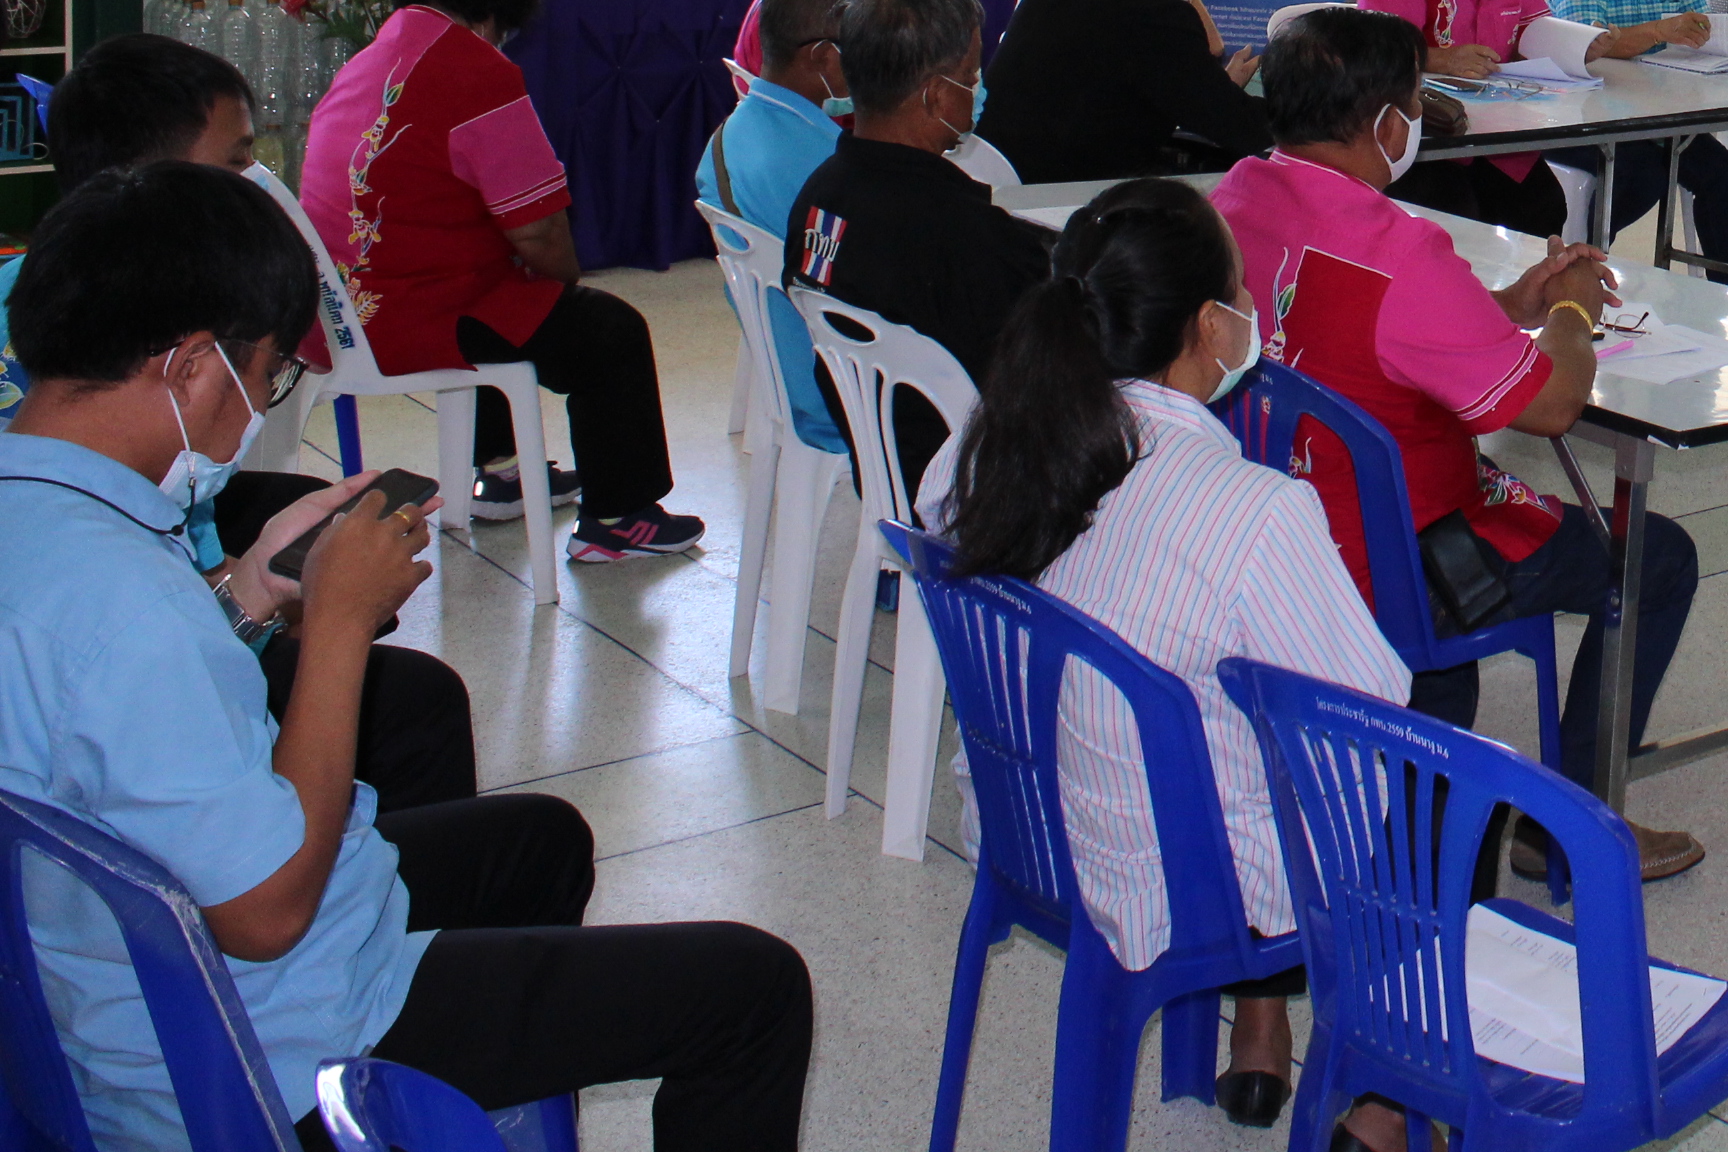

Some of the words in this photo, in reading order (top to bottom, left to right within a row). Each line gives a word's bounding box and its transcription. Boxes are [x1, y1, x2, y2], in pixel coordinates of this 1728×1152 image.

[1210, 4, 1239, 12] Facebook
[804, 228, 840, 262] กทบ
[319, 279, 344, 325] พนัสนิคม
[335, 326, 355, 350] 2561
